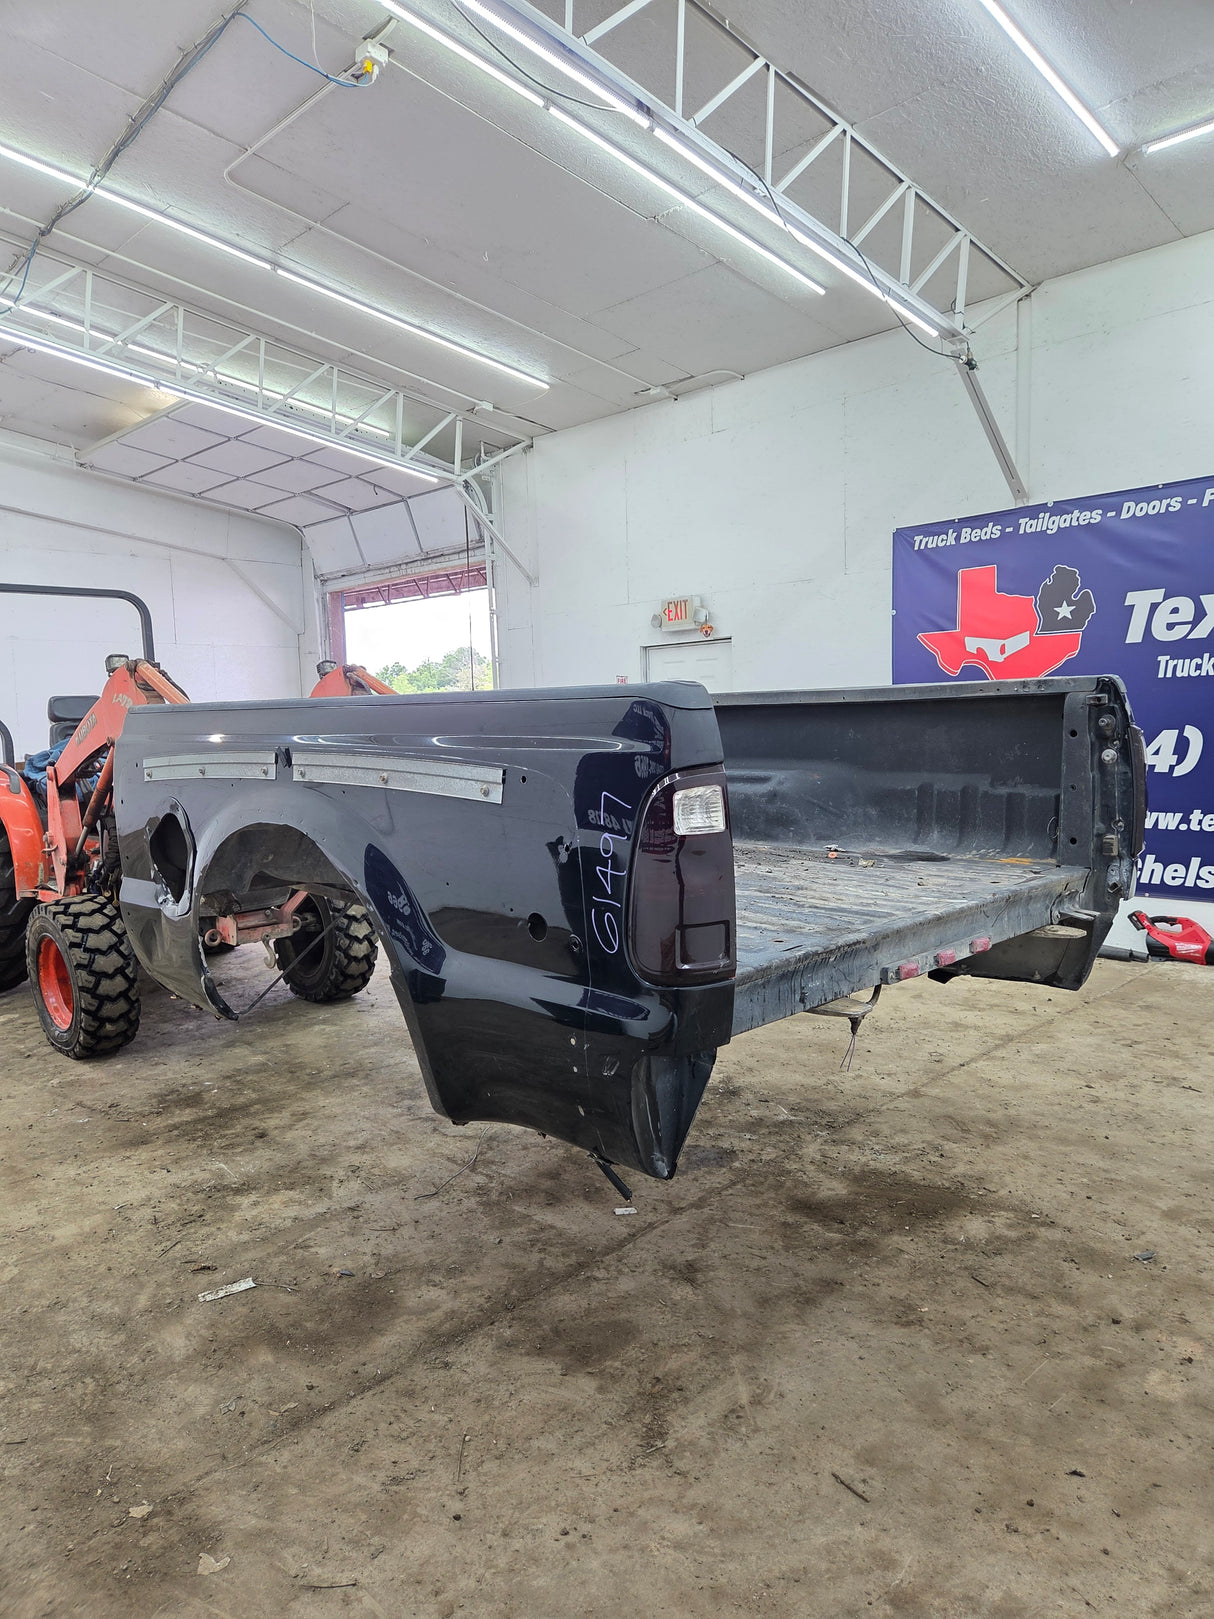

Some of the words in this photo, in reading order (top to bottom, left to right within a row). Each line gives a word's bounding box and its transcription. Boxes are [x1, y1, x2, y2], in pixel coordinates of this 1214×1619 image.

[914, 528, 957, 551] Truck
[960, 522, 1001, 544] Beds
[1018, 508, 1103, 534] Tailgates
[1120, 496, 1182, 520] Doors
[667, 599, 689, 622] EXIT
[1157, 652, 1214, 679] Truck
